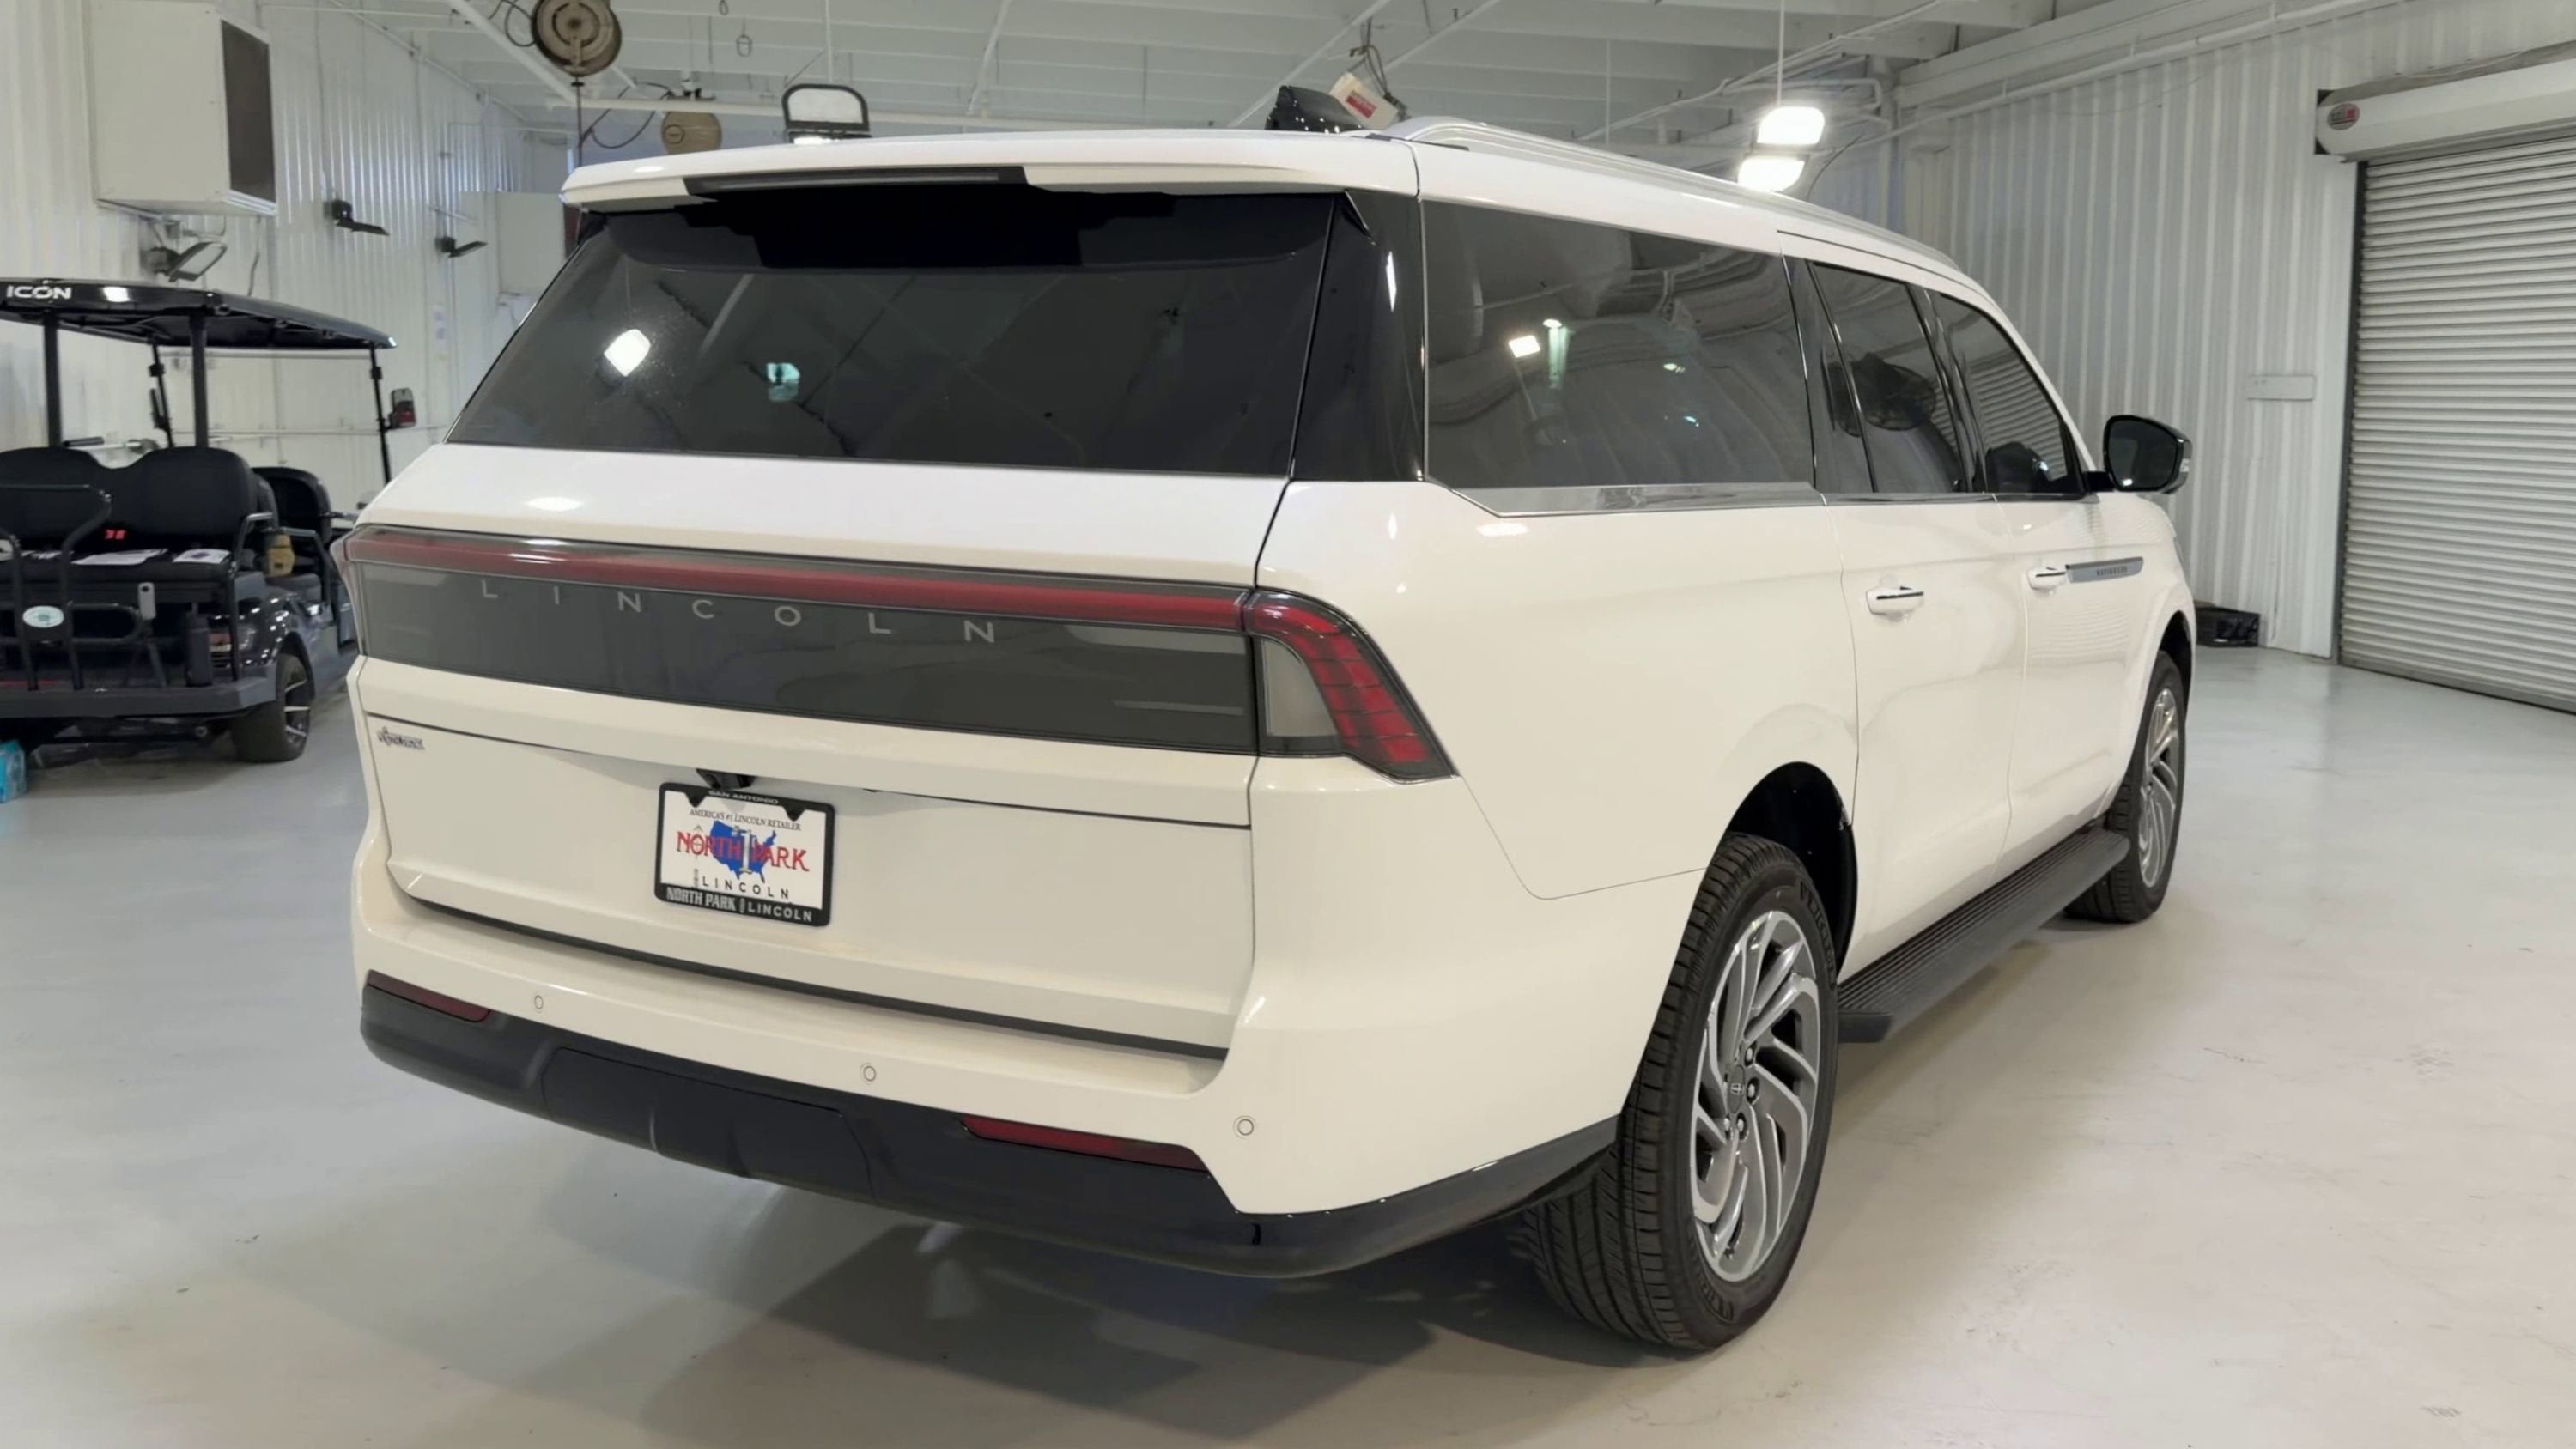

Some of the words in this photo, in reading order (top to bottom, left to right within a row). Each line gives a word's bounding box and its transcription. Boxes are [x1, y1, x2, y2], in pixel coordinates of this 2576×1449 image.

[6, 284, 72, 300] ICON
[481, 579, 996, 644] LINCOLN
[732, 793, 779, 804] ANTONIO
[690, 809, 725, 820] AMERICA'S
[734, 814, 766, 826] LINCOLN
[768, 818, 801, 831] RETAILER
[677, 831, 743, 861] NORTH
[751, 837, 810, 871] PARK
[702, 876, 789, 900] LINCOLN
[666, 887, 702, 906] NORTH
[705, 892, 736, 912] PARK
[747, 901, 812, 922] LINCOLN
